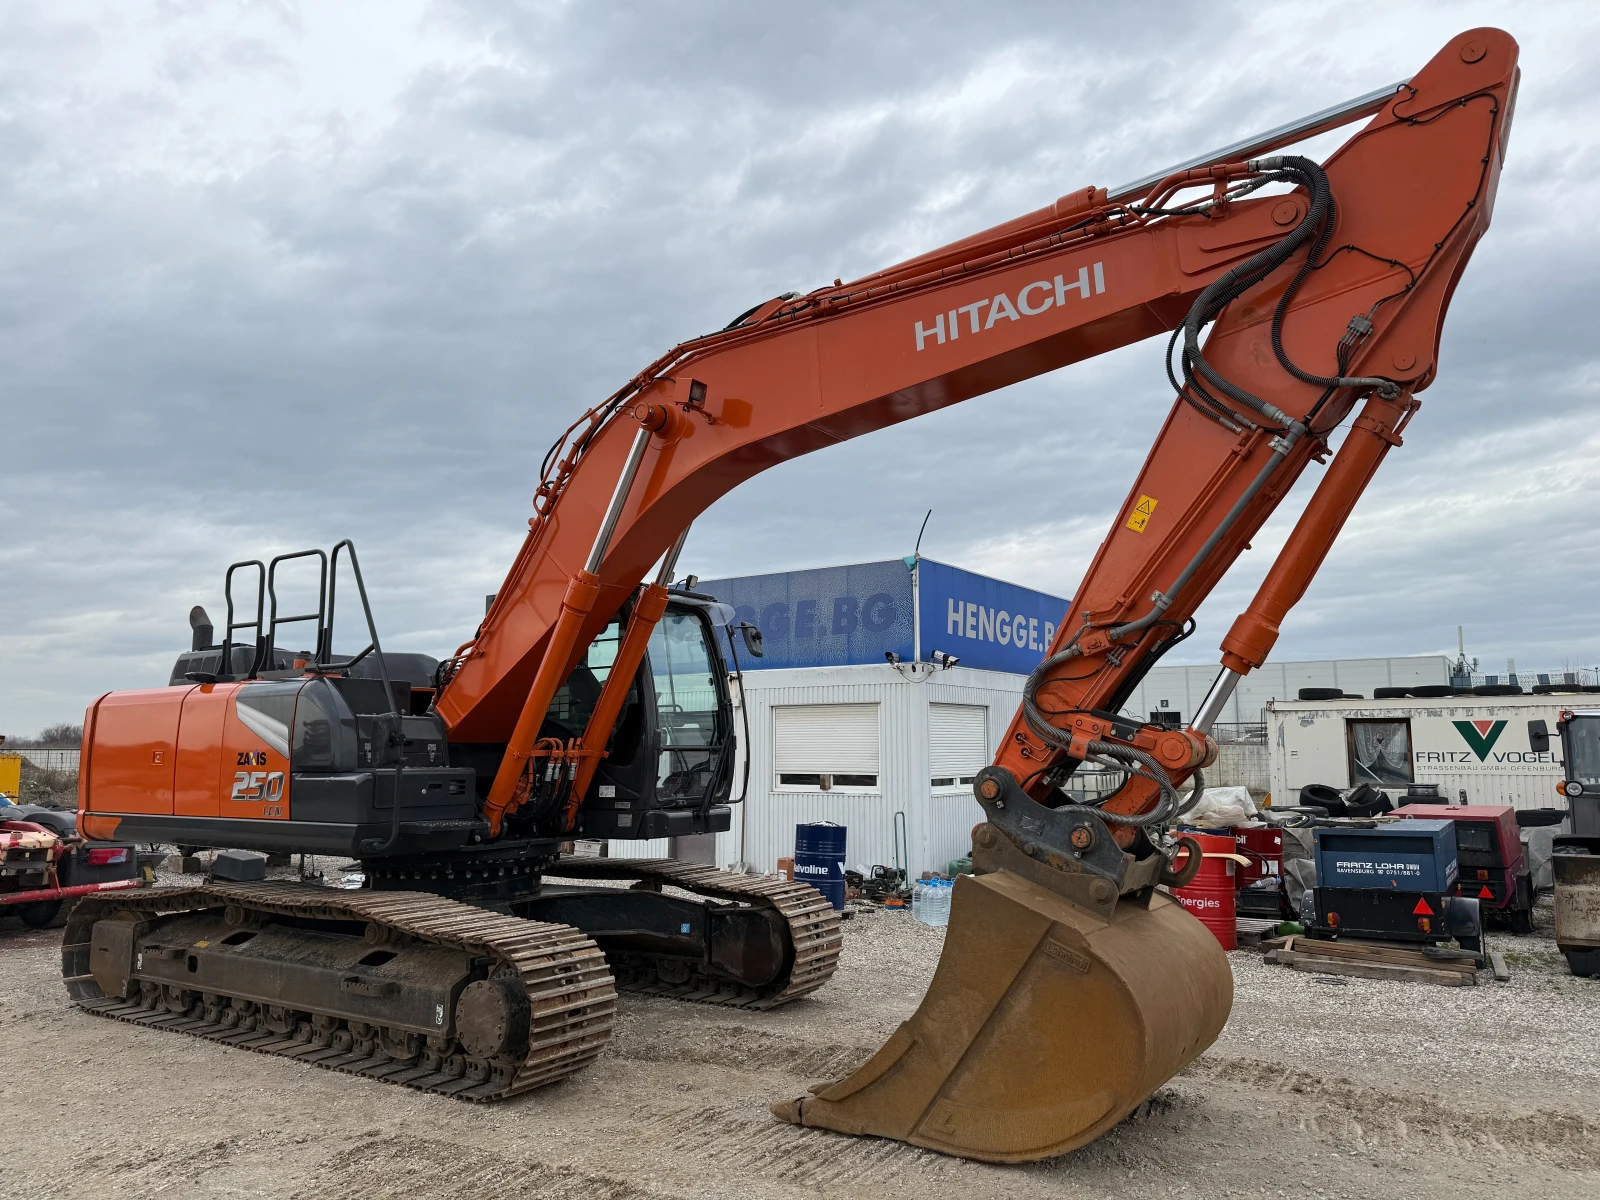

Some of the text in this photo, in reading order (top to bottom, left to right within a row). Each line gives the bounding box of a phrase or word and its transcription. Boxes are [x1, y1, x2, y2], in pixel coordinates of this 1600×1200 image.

[914, 261, 1106, 352] HITACHI
[717, 592, 897, 644] GGE.BG
[947, 597, 1061, 653] HENGGE.B
[237, 749, 267, 766] ZAXIS
[1416, 751, 1563, 763] FRITZ VOGEL
[231, 771, 285, 802] 250
[1236, 835, 1247, 845] bil
[794, 863, 829, 875] alvoline
[1336, 861, 1373, 869] FRANZ
[1375, 862, 1405, 870] LOHR
